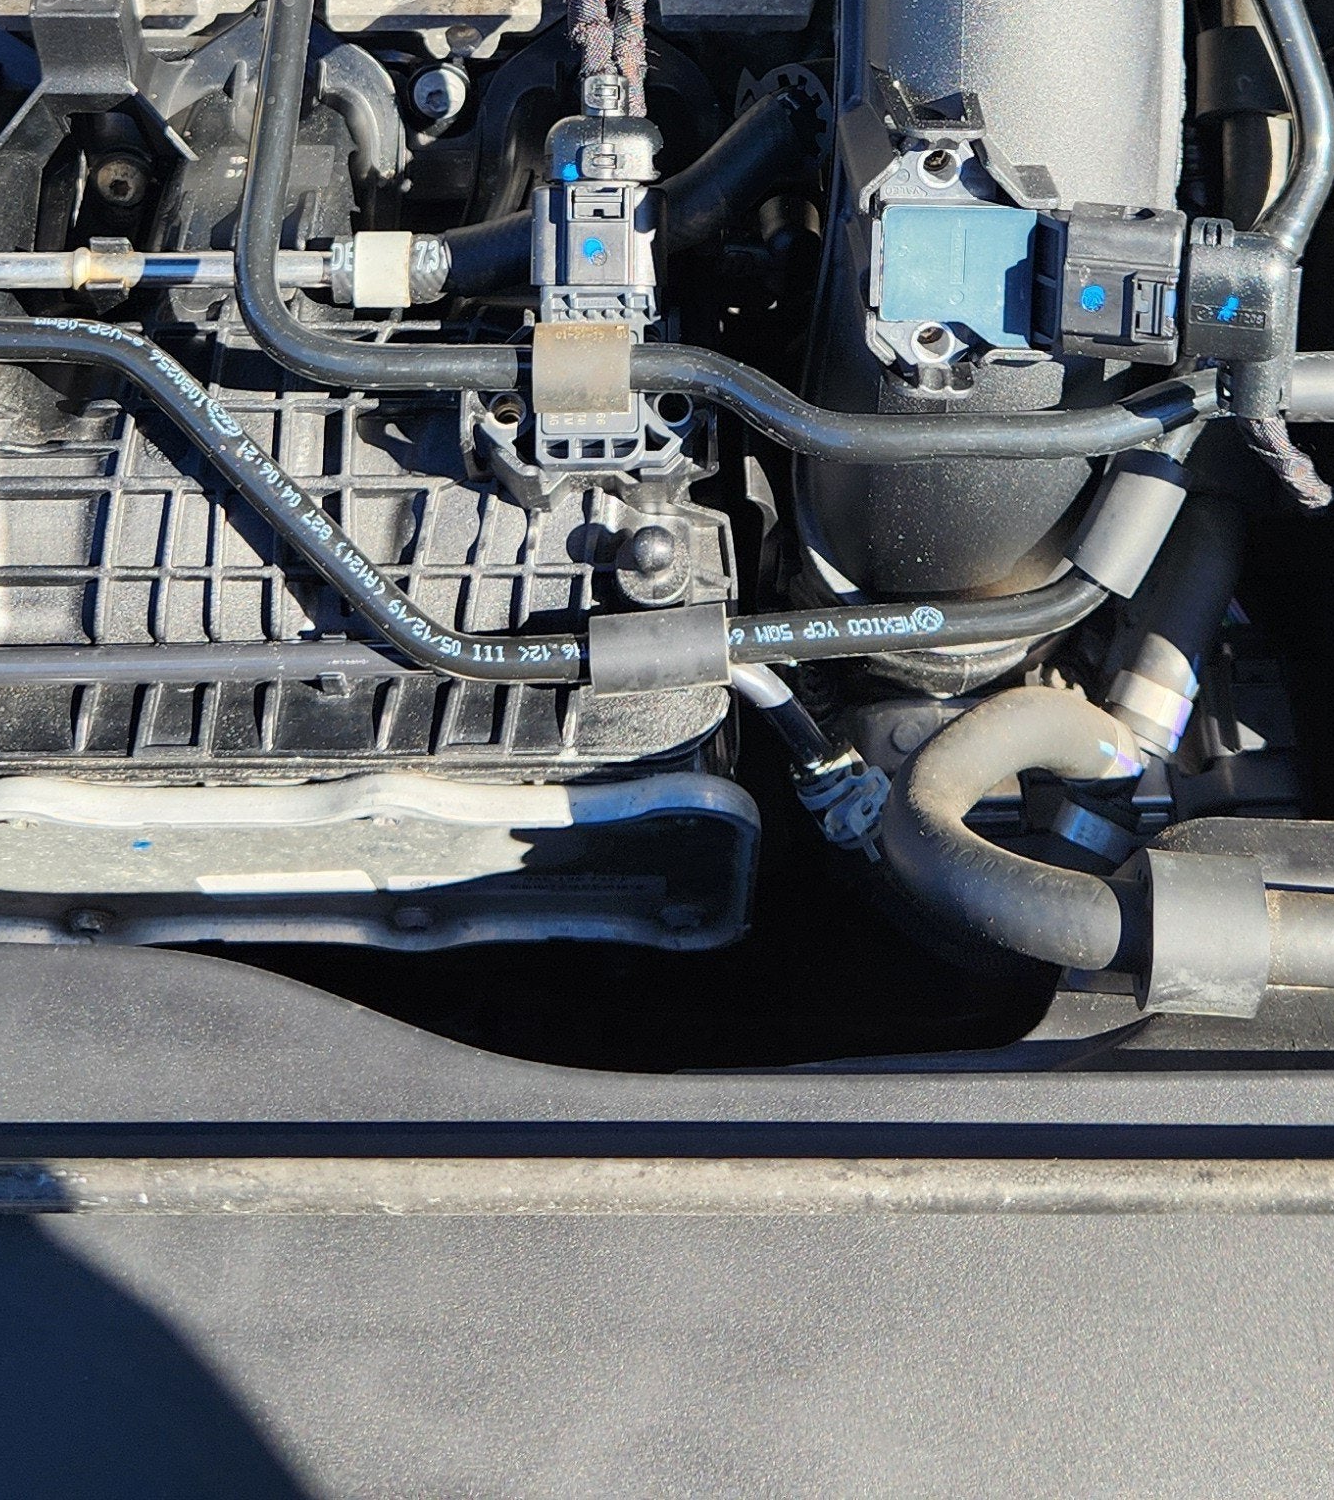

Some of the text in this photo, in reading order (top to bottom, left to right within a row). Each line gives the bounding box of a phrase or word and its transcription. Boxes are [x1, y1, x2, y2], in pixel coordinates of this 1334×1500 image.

[298, 505, 335, 545] 827
[330, 536, 389, 602] (A121)
[381, 594, 466, 662] 05/12/19
[753, 622, 794, 643] 5QM
[801, 619, 839, 639] YCP
[846, 614, 916, 637] MEXICO
[471, 643, 505, 662] III
